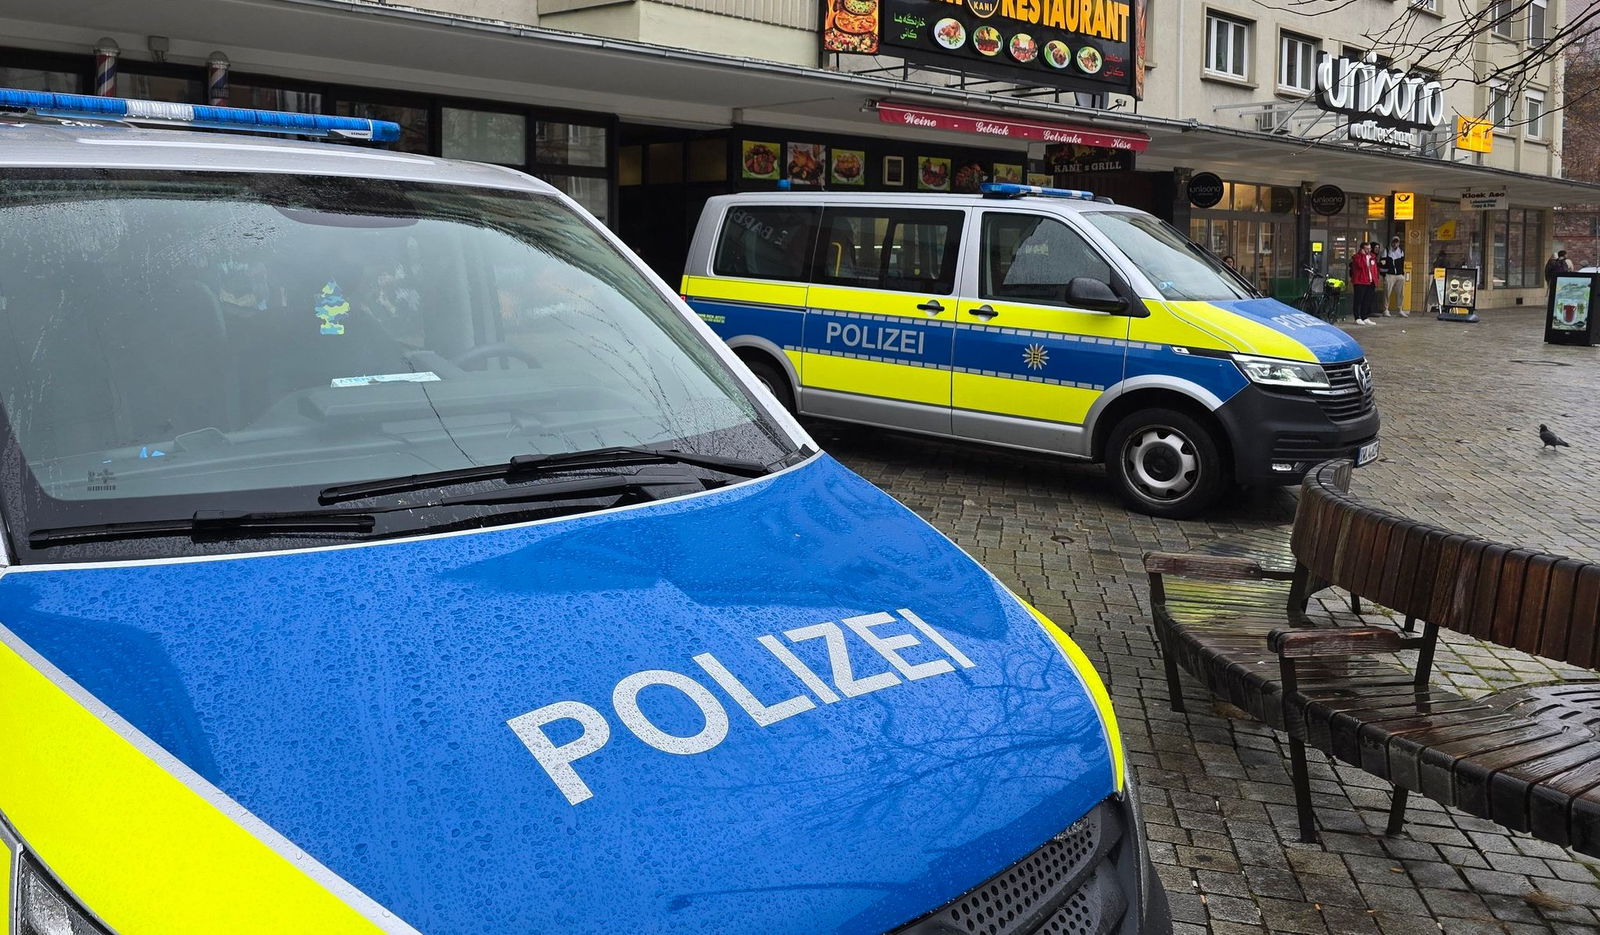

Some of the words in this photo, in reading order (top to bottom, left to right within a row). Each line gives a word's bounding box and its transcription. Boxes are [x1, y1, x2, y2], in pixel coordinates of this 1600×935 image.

[973, 2, 993, 11] KANI
[904, 113, 937, 127] Weine
[975, 121, 1010, 136] Gebäck
[1091, 161, 1122, 170] GRILL
[826, 321, 925, 355] POLIZEI
[506, 608, 976, 806] POLIZEI
